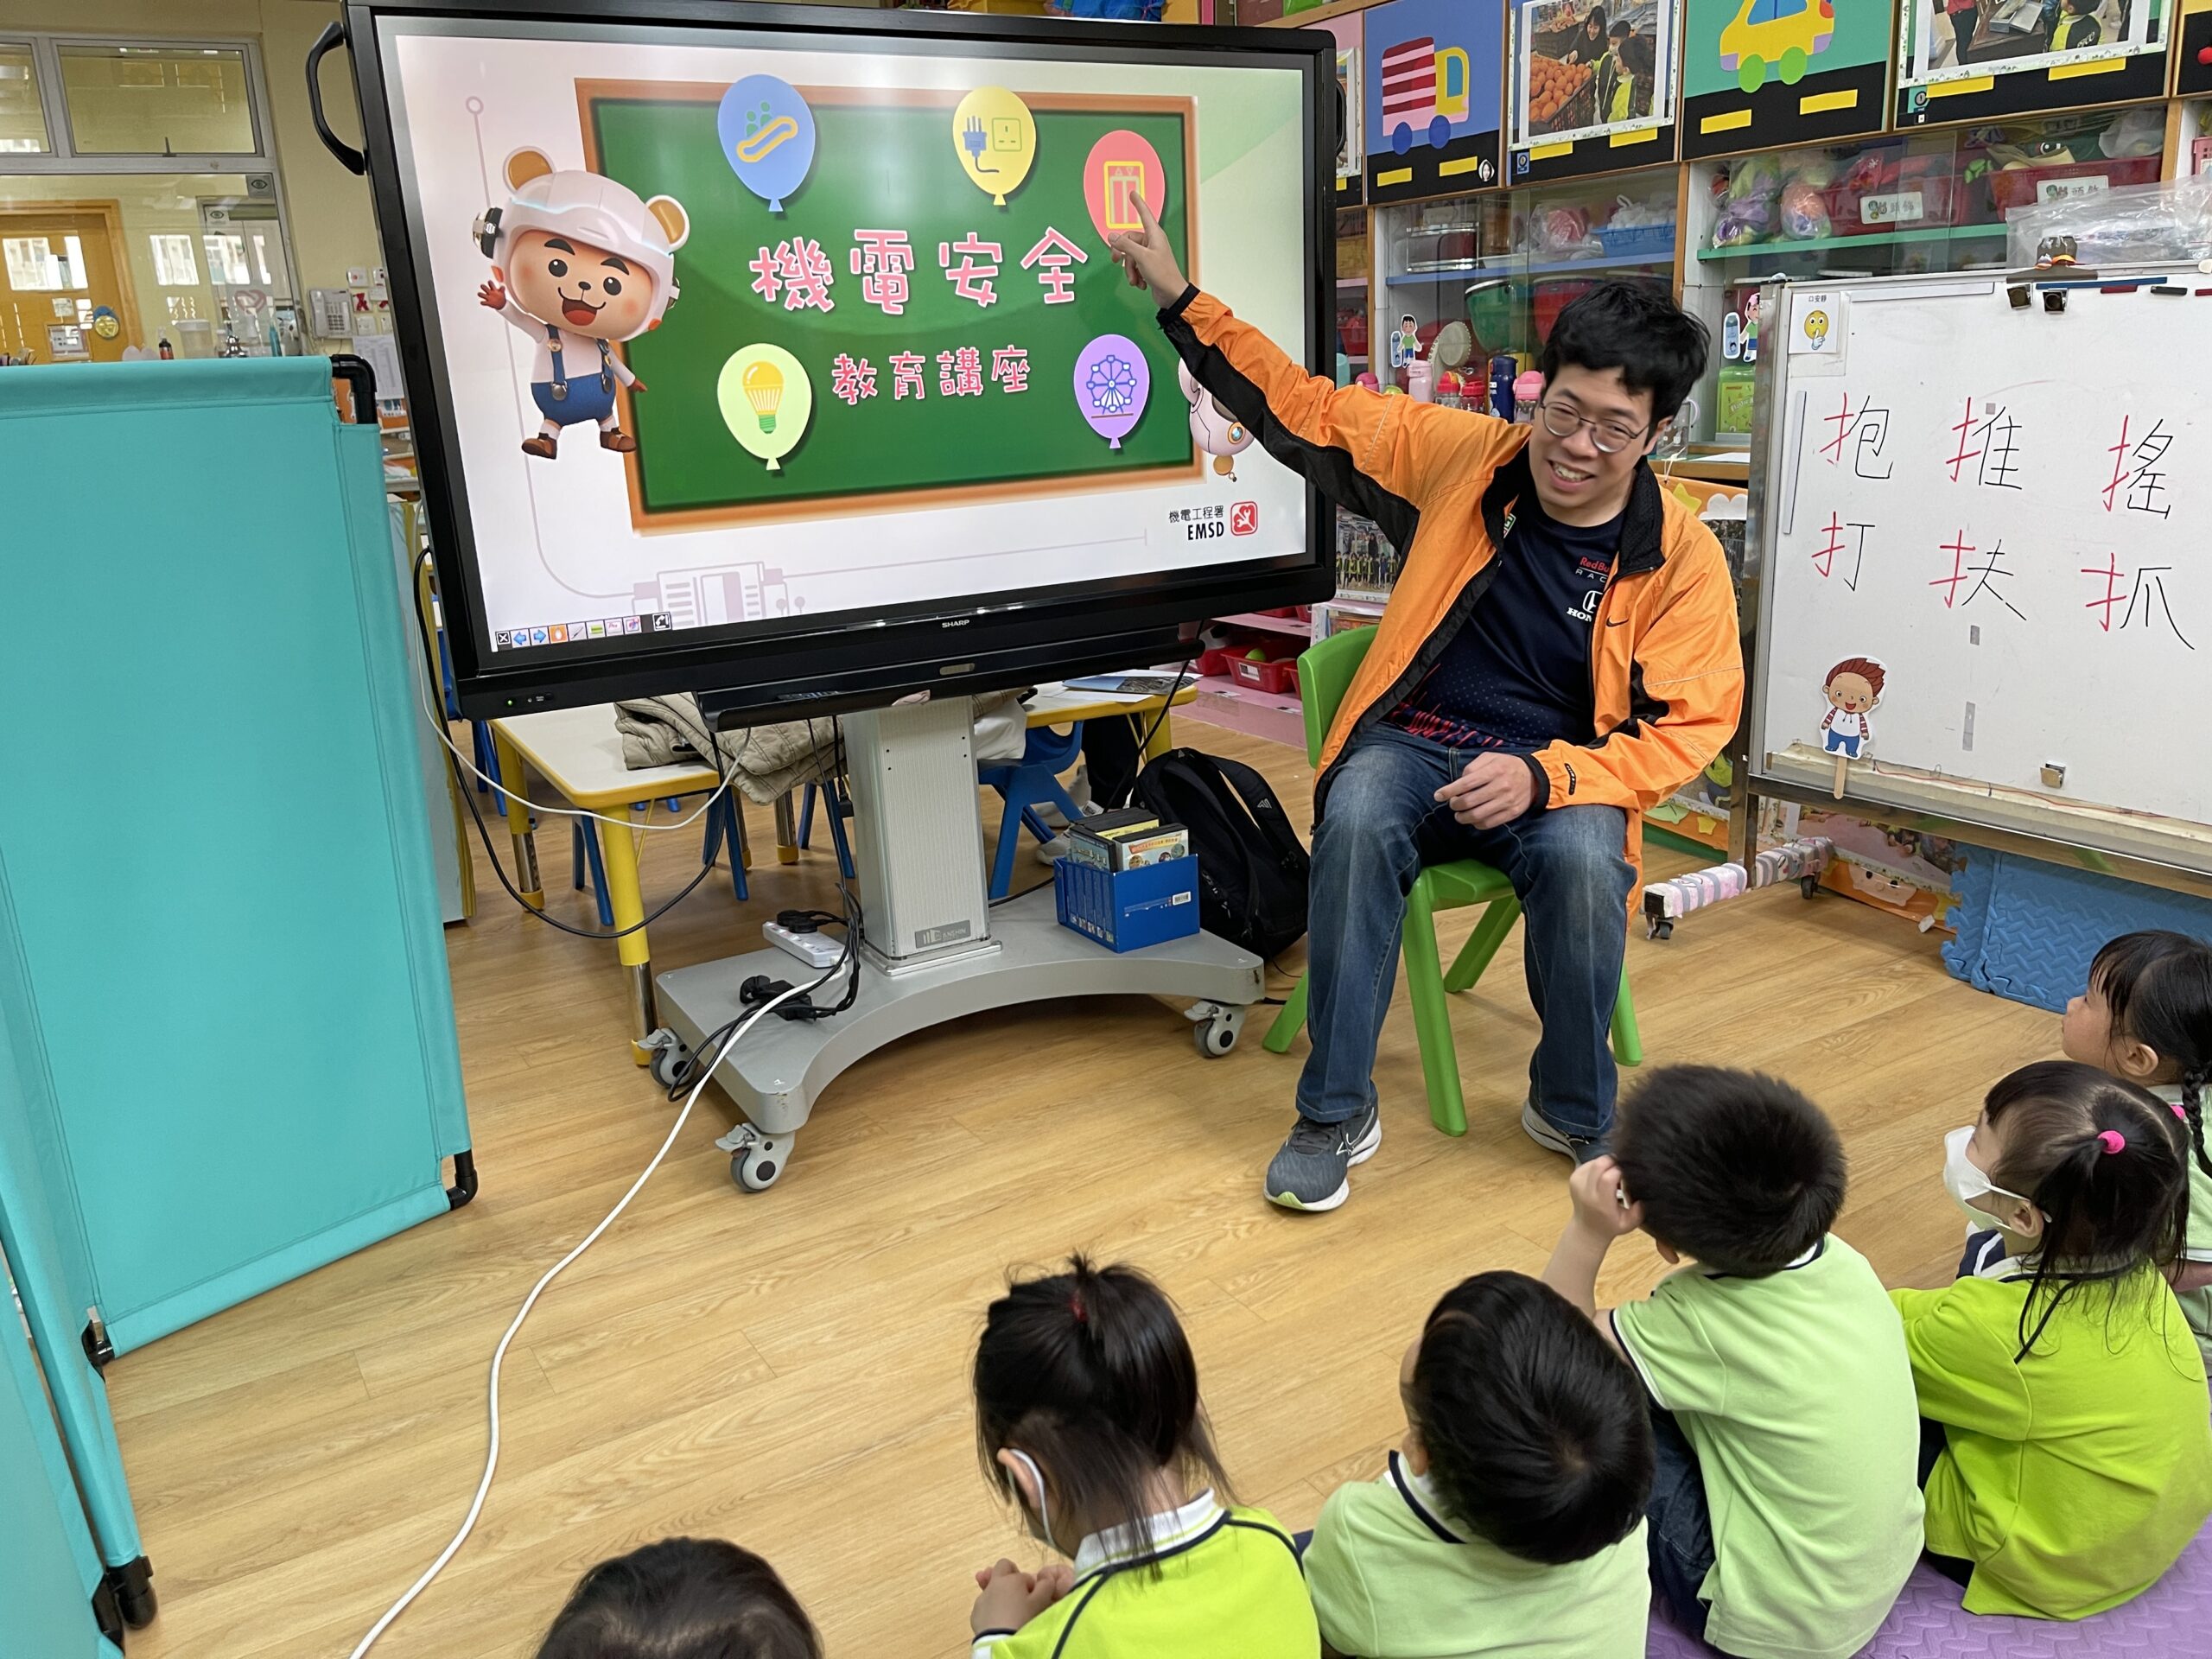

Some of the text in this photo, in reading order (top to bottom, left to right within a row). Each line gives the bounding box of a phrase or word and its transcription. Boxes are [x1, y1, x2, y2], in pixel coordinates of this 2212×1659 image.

[749, 226, 1089, 315] 機電安全
[831, 344, 1030, 407] 教育講座
[1820, 392, 2174, 520] 抱 推 搖
[1169, 505, 1224, 523] 機電工程署
[1187, 522, 1224, 540] EMSD
[1811, 511, 2195, 650] 打 扶 抓
[942, 620, 969, 628] SHARP
